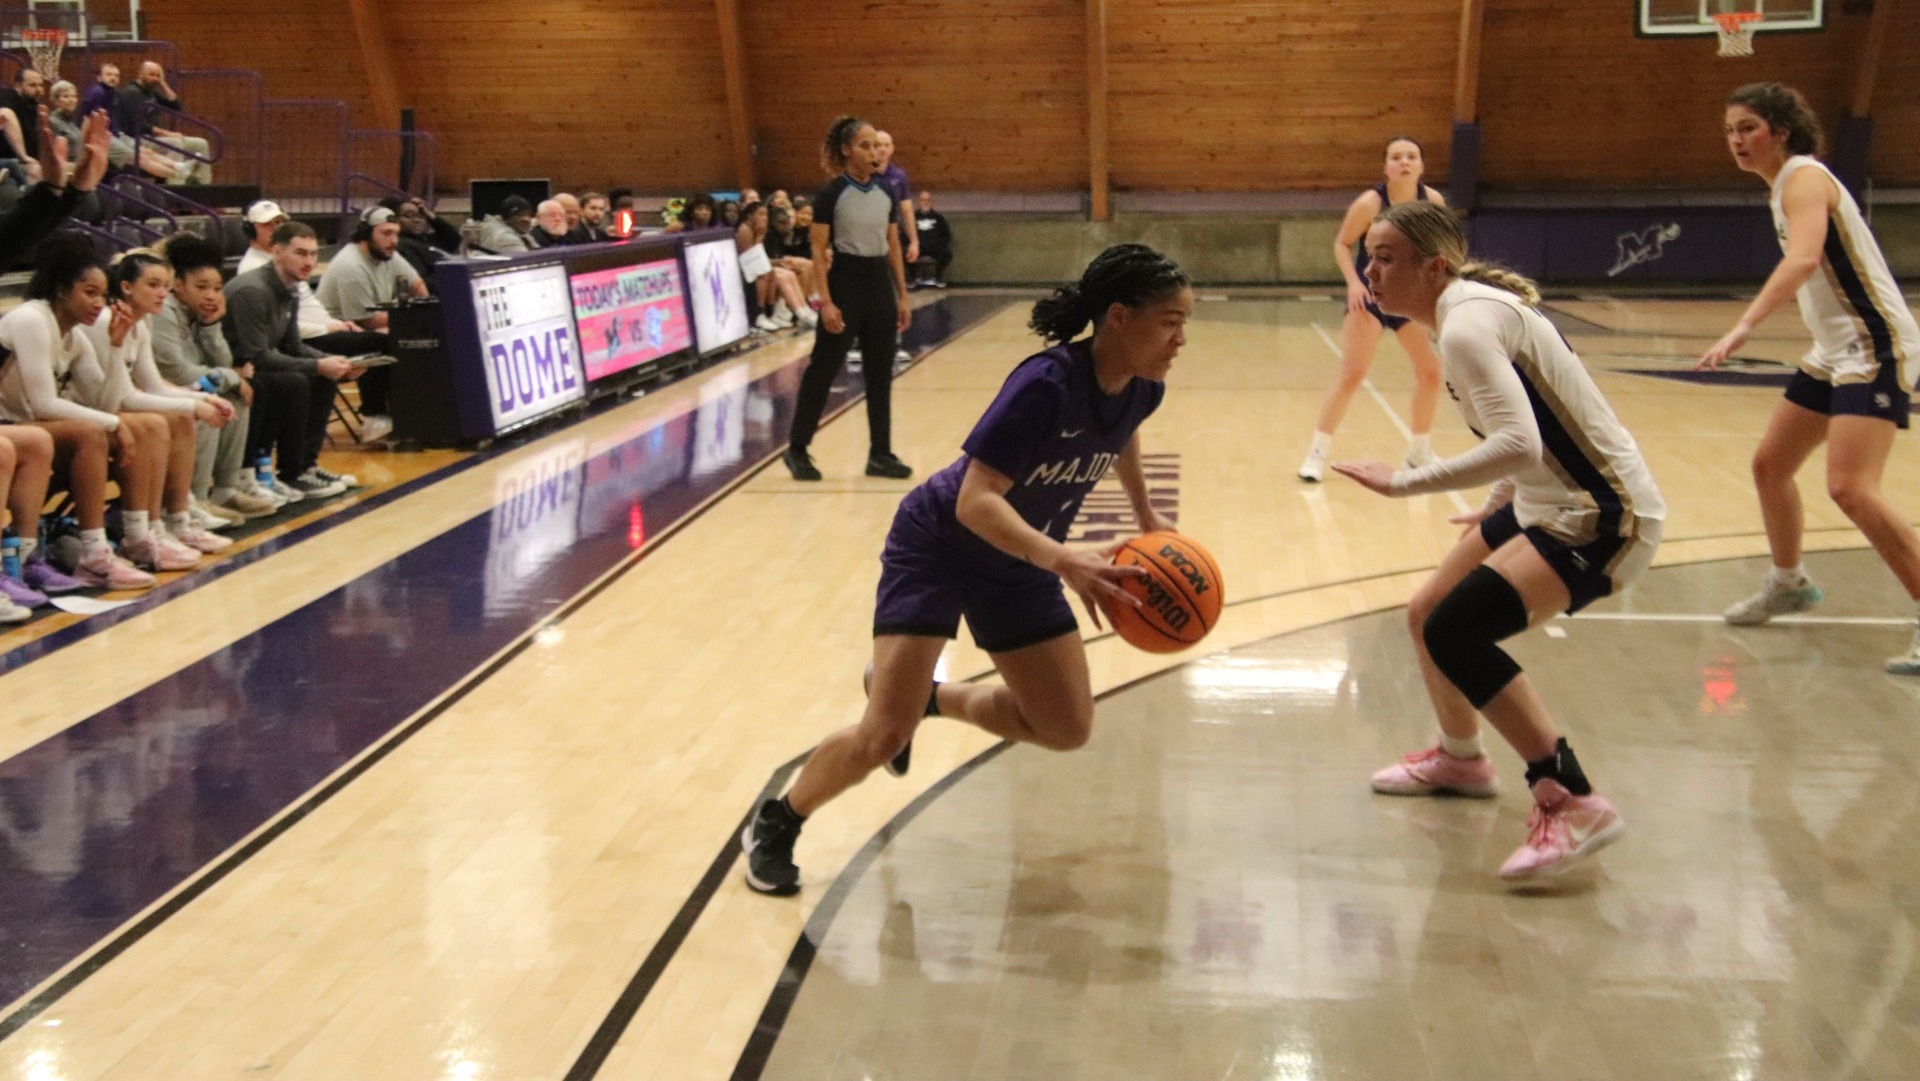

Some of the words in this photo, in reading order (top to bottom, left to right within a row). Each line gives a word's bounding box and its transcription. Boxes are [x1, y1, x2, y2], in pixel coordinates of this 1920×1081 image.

[480, 286, 511, 330] THE
[576, 280, 622, 314] TODAY'S
[622, 271, 674, 303] MATCHUPS
[490, 327, 576, 414] DOME
[1159, 544, 1211, 595] NCAA
[1134, 559, 1190, 634] Wilso
